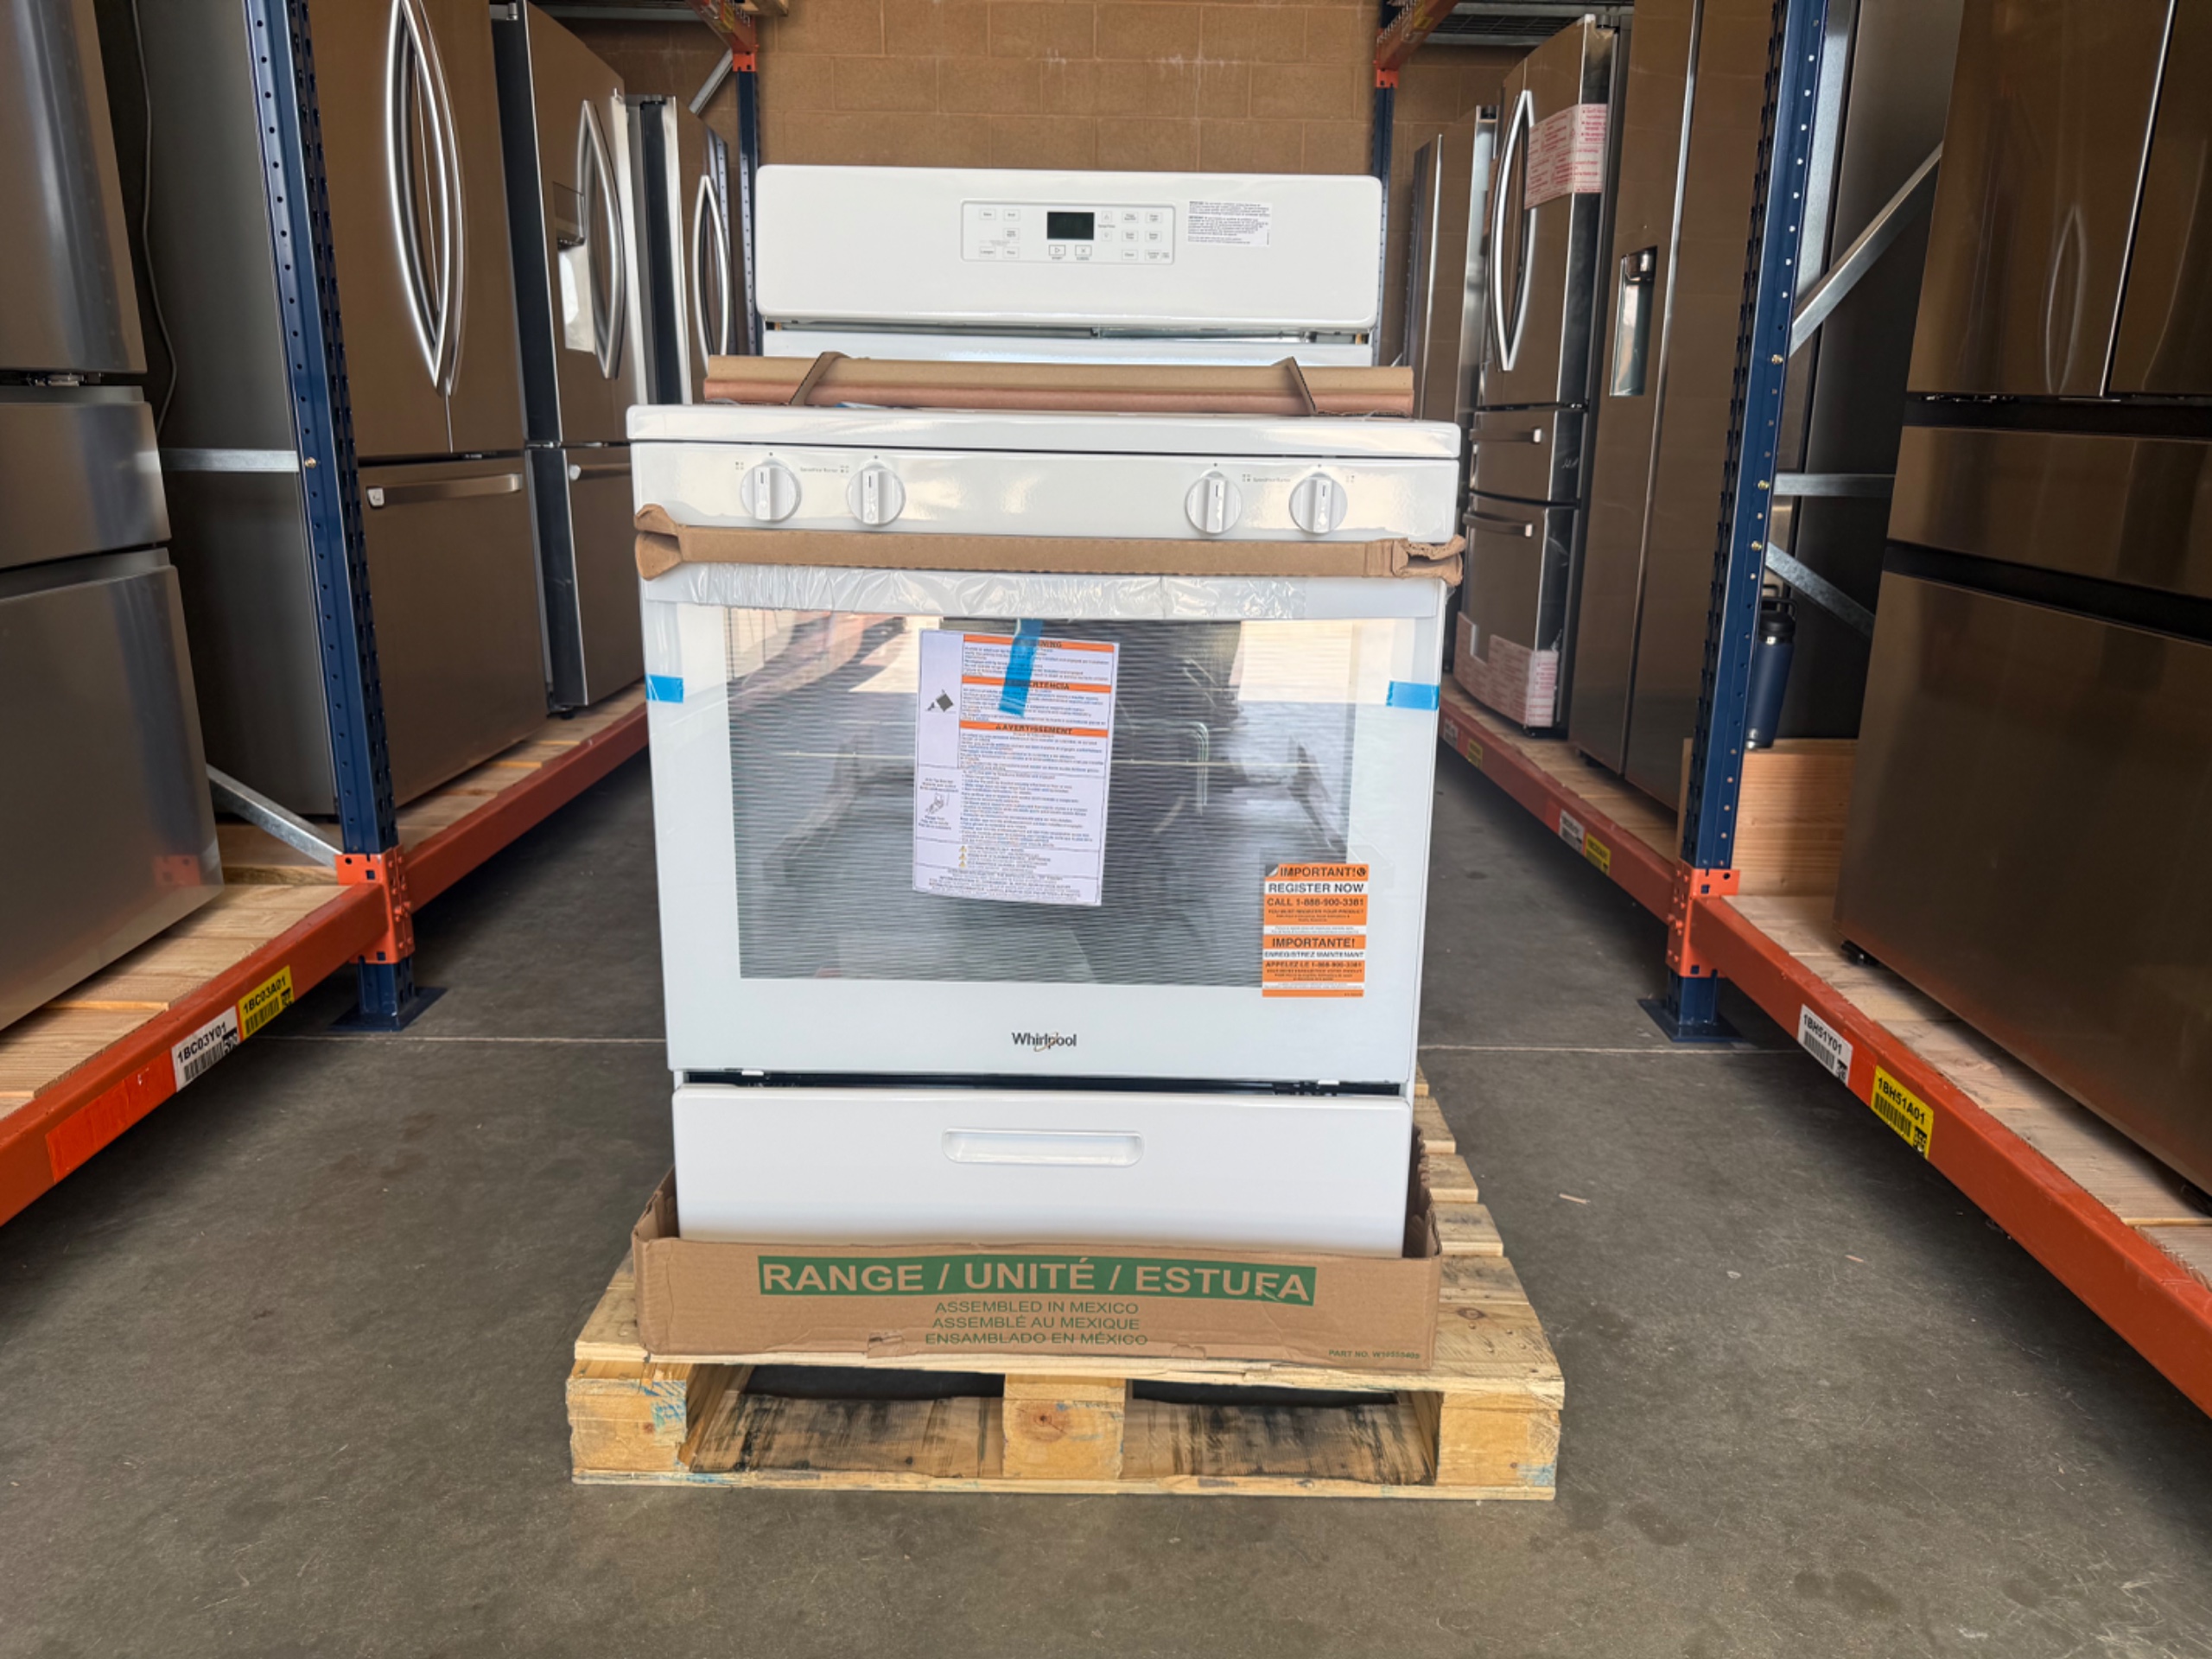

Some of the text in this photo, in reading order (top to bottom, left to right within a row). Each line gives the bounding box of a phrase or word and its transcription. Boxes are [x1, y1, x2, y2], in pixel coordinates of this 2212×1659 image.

[1280, 867, 1356, 877] IMPORTANT!
[1268, 883, 1364, 893] REGISTER NOW
[1267, 898, 1293, 906] CALL
[1272, 938, 1355, 948] IMPORTANTE!
[243, 976, 286, 1014] 1BC03A01
[177, 1021, 227, 1063] 1BC03Y01
[1011, 1032, 1077, 1051] Whirlpool
[1803, 1014, 1843, 1056] 1BH51Y01
[1878, 1077, 1925, 1124] 1BH51A01
[763, 1263, 924, 1292] RANGE
[963, 1257, 1095, 1290] UNITÉ
[1135, 1265, 1311, 1301] ESTUFA
[935, 1300, 1139, 1314] ASSEMBLED IN MEXICO
[932, 1315, 1140, 1330] ASSEMBLÉ AU MEXIQUE
[925, 1332, 1148, 1345] ENSAMBLADO EN MÉXICO
[1328, 1349, 1352, 1357] PART
